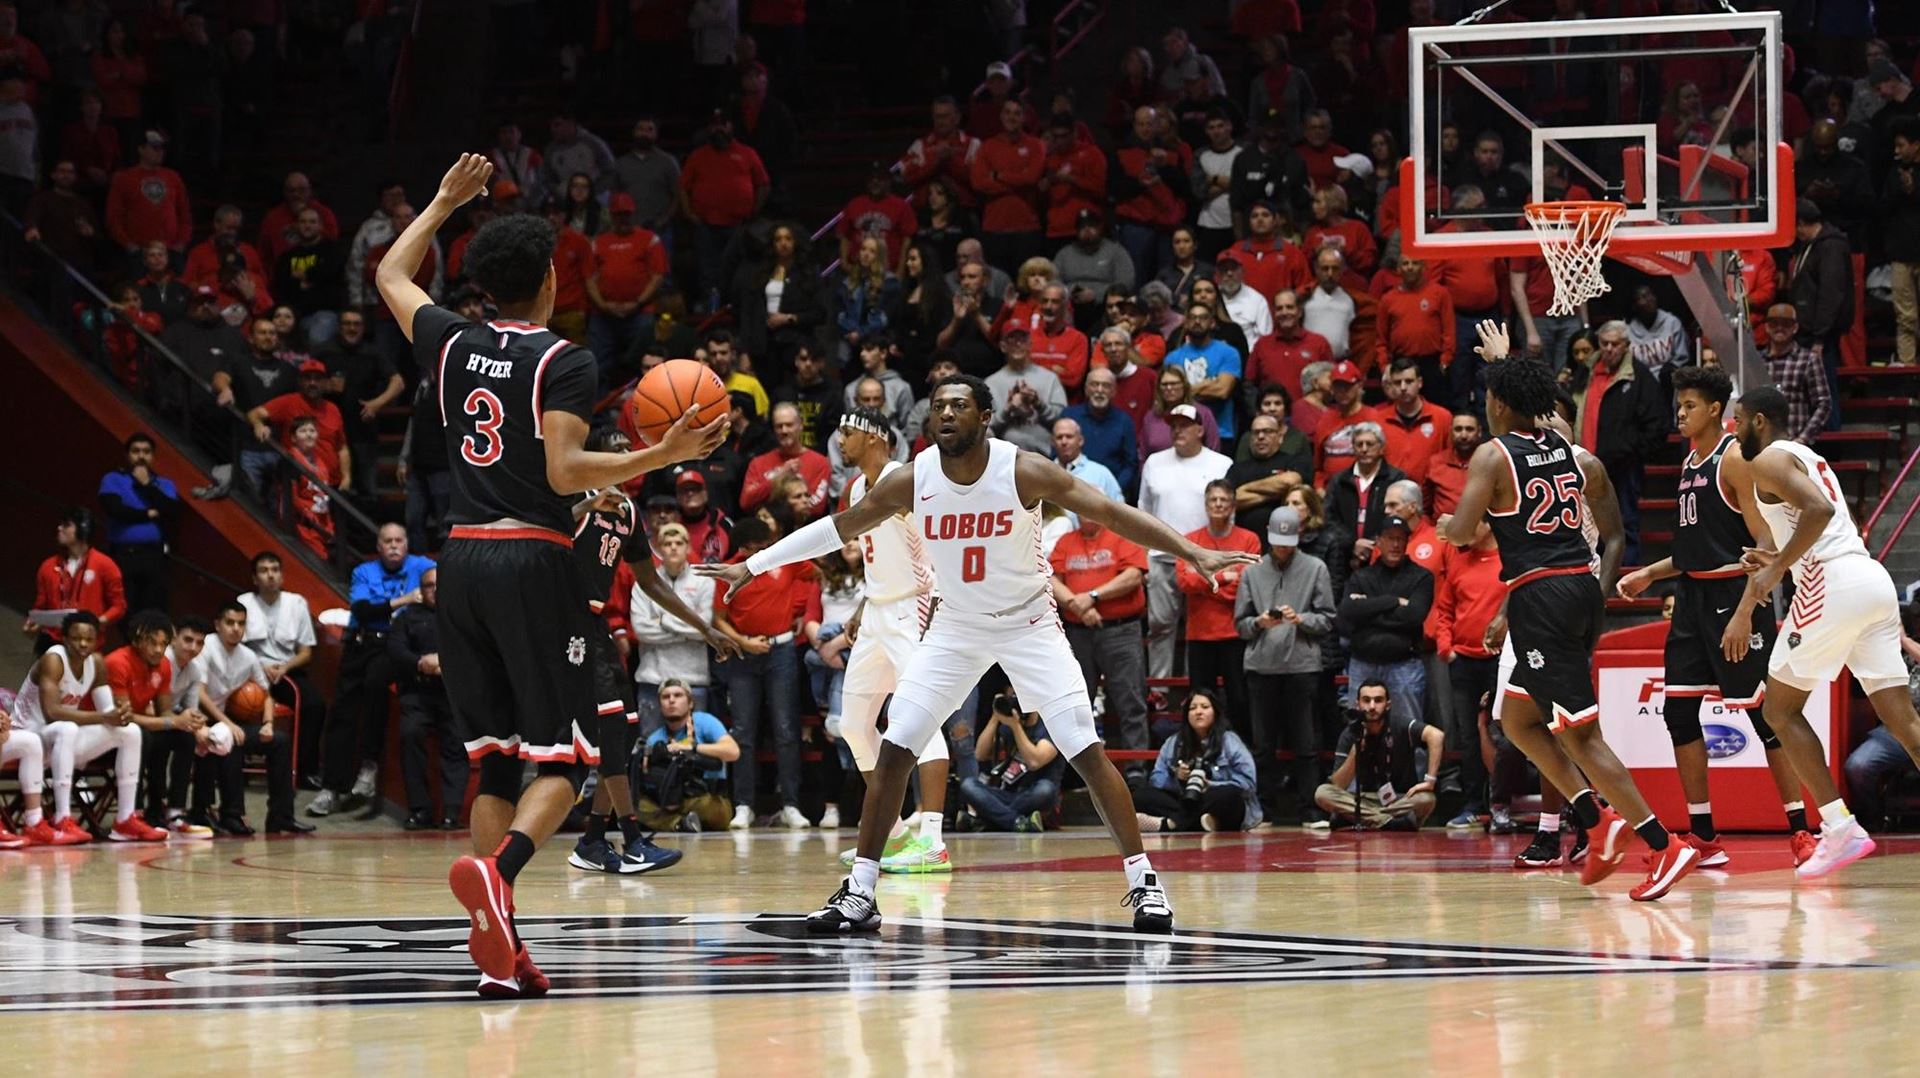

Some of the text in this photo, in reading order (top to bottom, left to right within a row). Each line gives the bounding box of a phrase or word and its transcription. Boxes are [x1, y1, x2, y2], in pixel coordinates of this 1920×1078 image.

[466, 353, 513, 379] HYDER
[461, 387, 505, 467] 3
[1525, 447, 1567, 467] HOLLAND
[1525, 471, 1582, 534] 25
[1679, 492, 1698, 527] 10
[924, 509, 1014, 540] LOBOS
[599, 532, 621, 567] 13
[963, 546, 986, 583] 0
